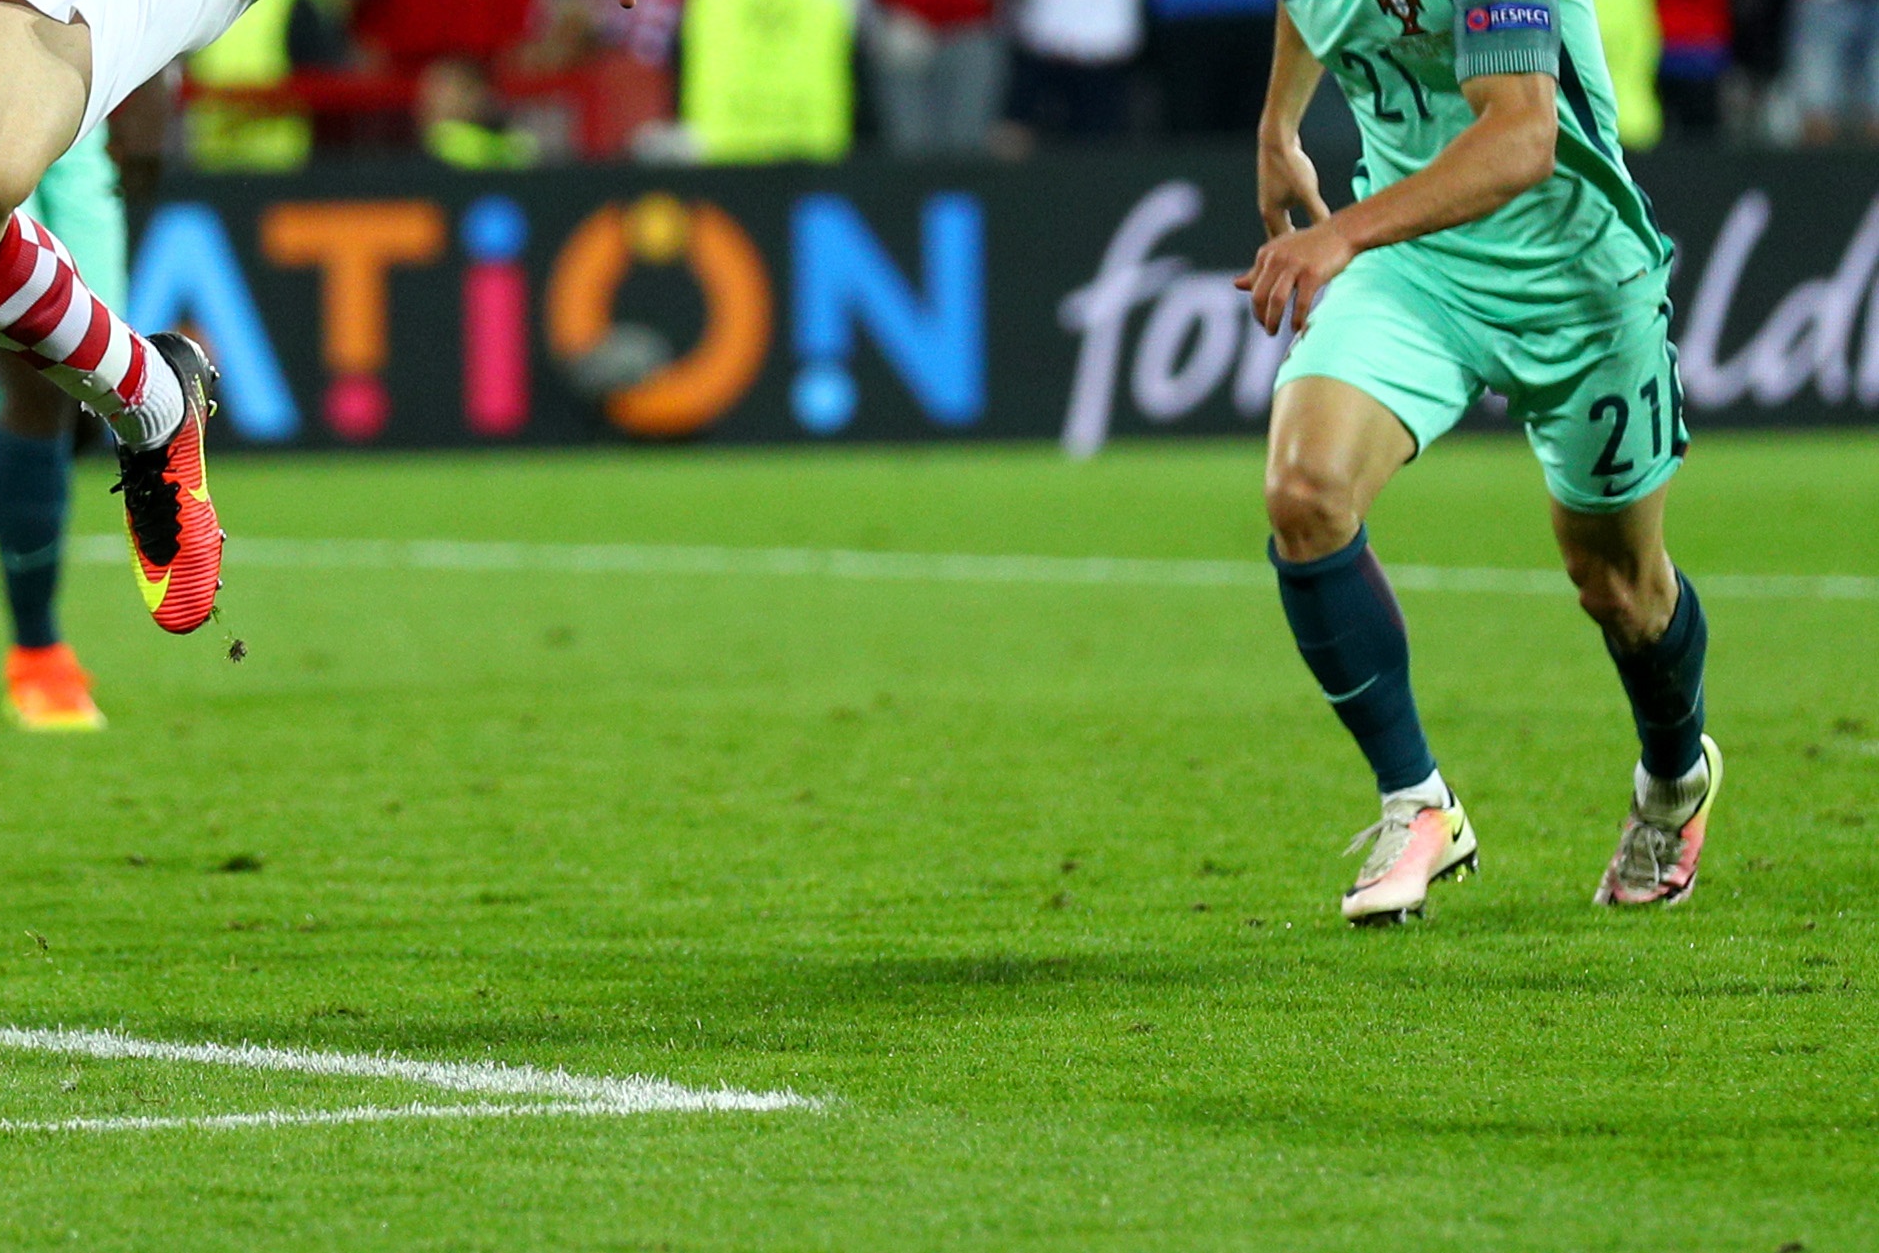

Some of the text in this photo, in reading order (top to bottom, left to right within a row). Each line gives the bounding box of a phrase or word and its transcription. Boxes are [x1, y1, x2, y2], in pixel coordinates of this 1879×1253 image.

[1489, 8, 1550, 26] RESPECT
[1340, 48, 1434, 123] 21
[1589, 373, 1662, 477] 21
